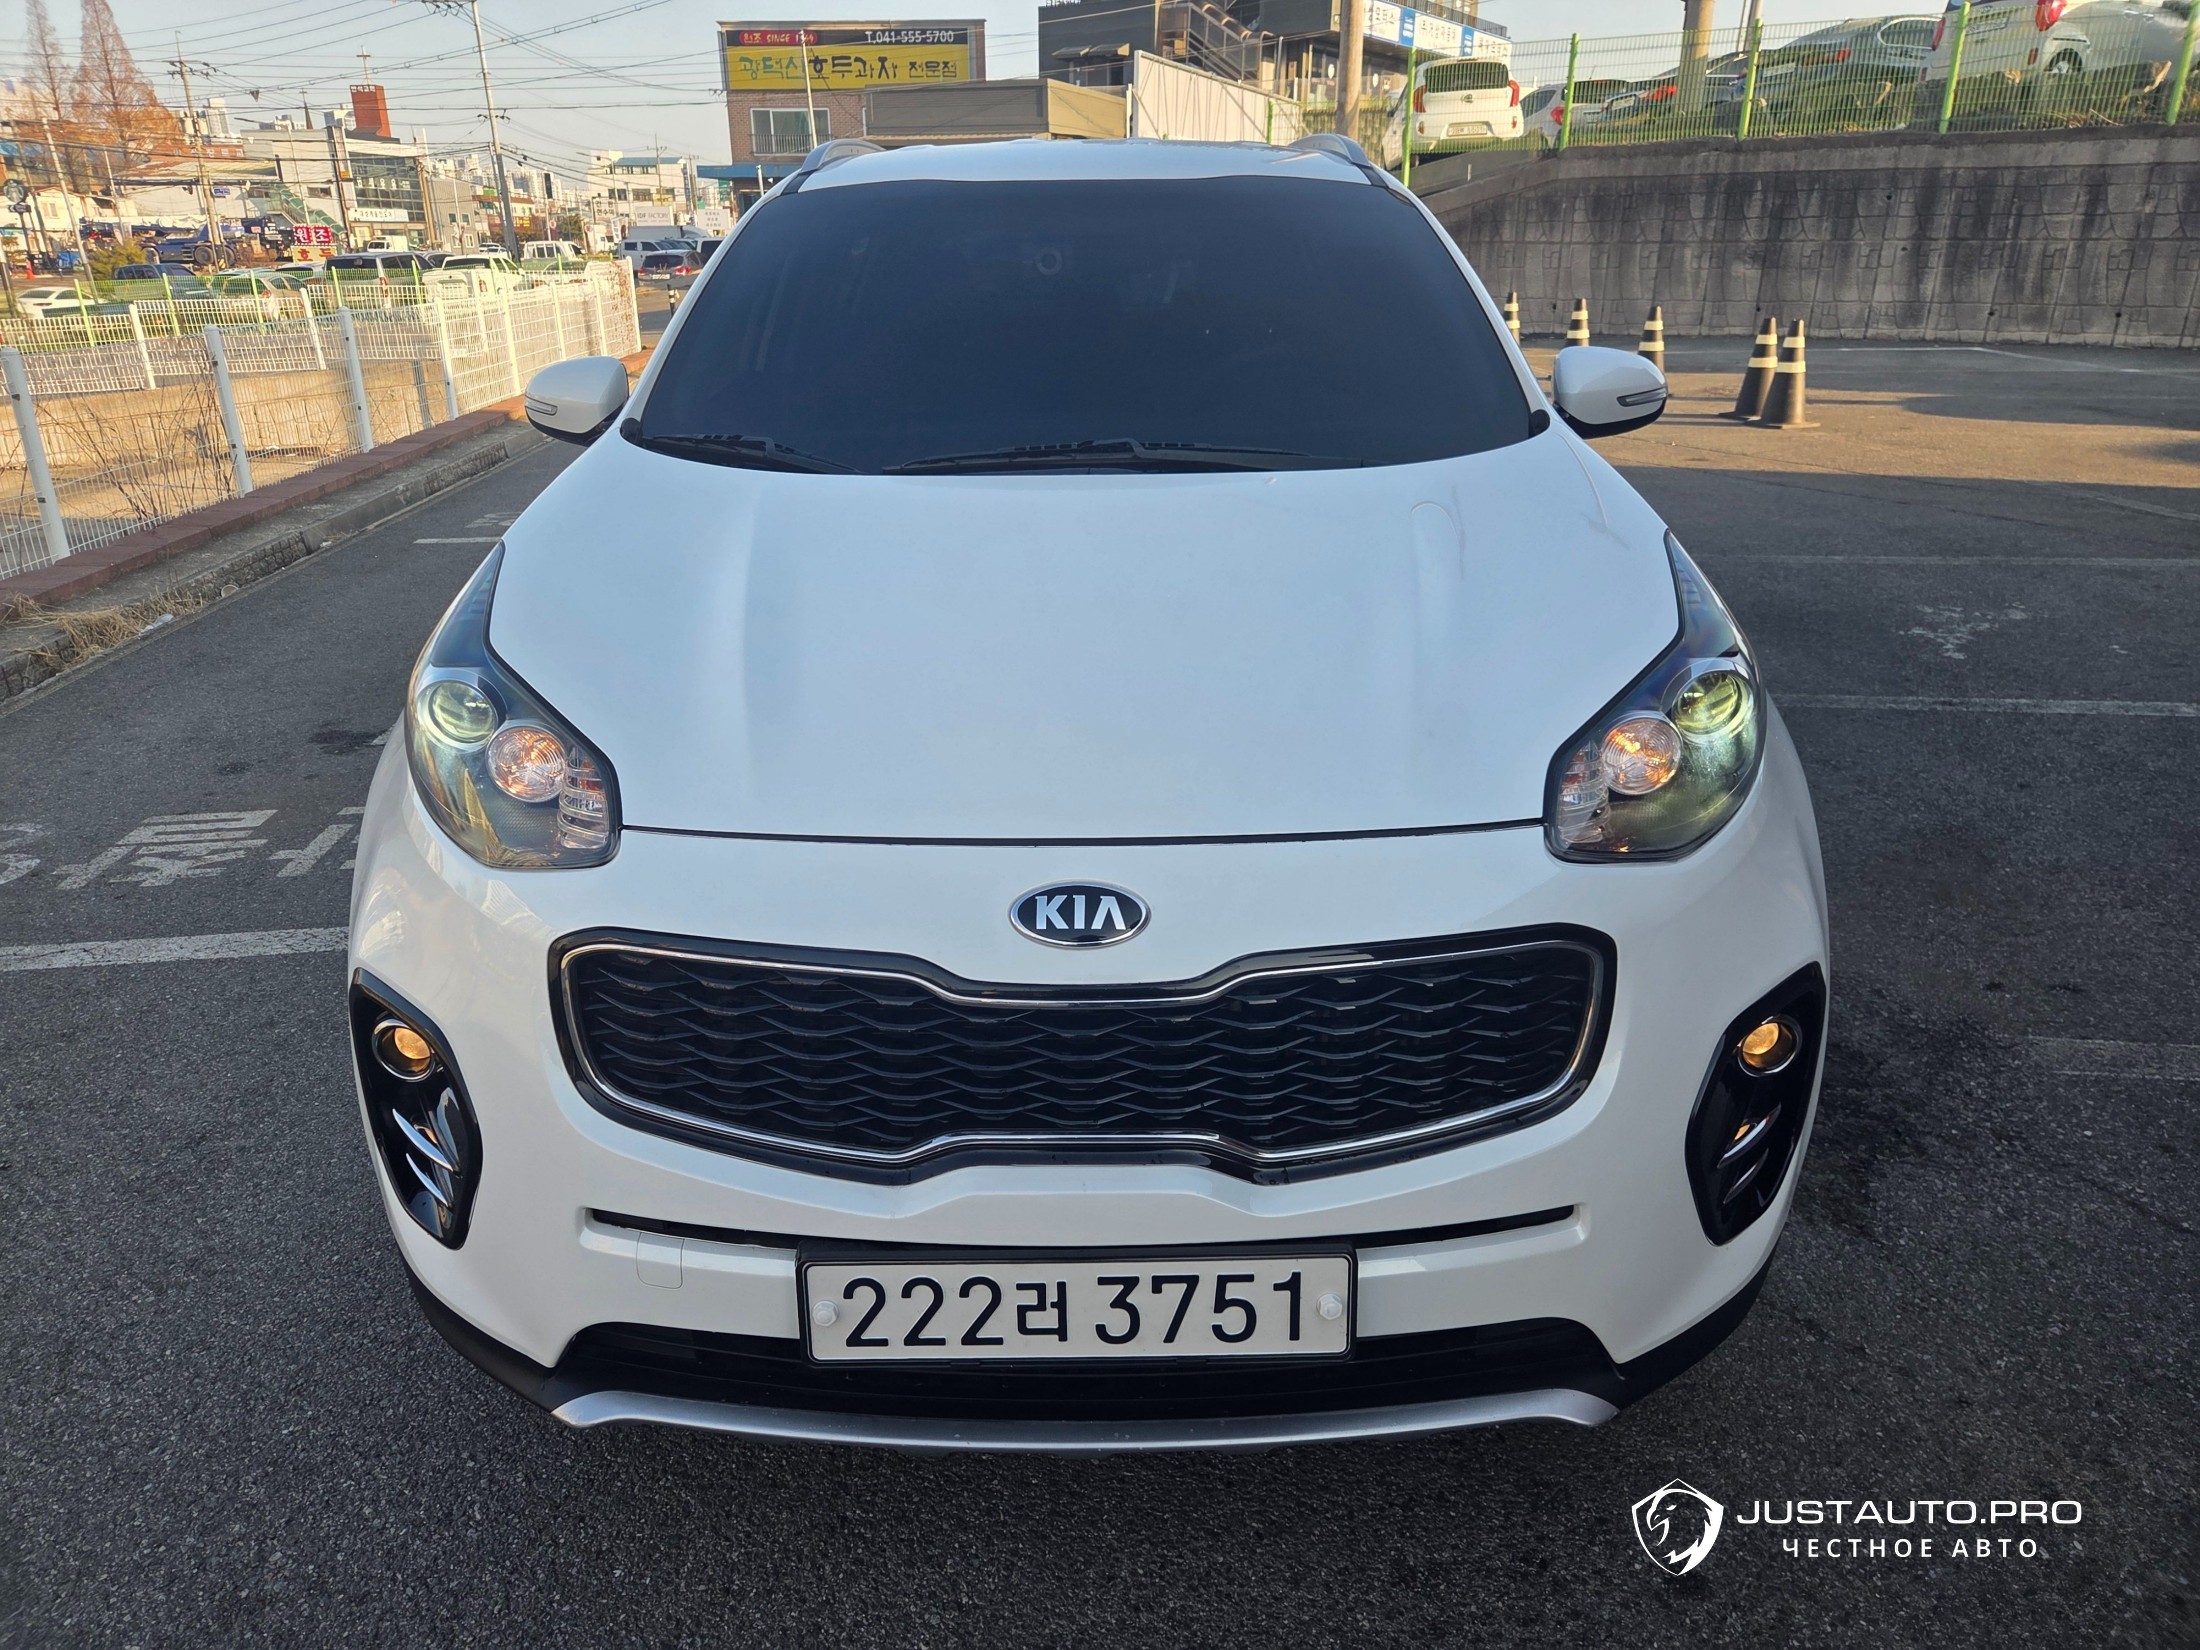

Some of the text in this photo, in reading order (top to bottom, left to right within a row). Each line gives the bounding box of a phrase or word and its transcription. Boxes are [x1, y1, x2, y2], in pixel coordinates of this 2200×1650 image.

[766, 33, 791, 43] SINCE
[865, 30, 955, 45] T.041-555-5700
[807, 55, 898, 80] 호두과자
[908, 60, 958, 79] 전문점
[294, 227, 330, 243] 원조
[1034, 894, 1127, 931] KIA
[843, 1271, 1302, 1348] 222러 3751
